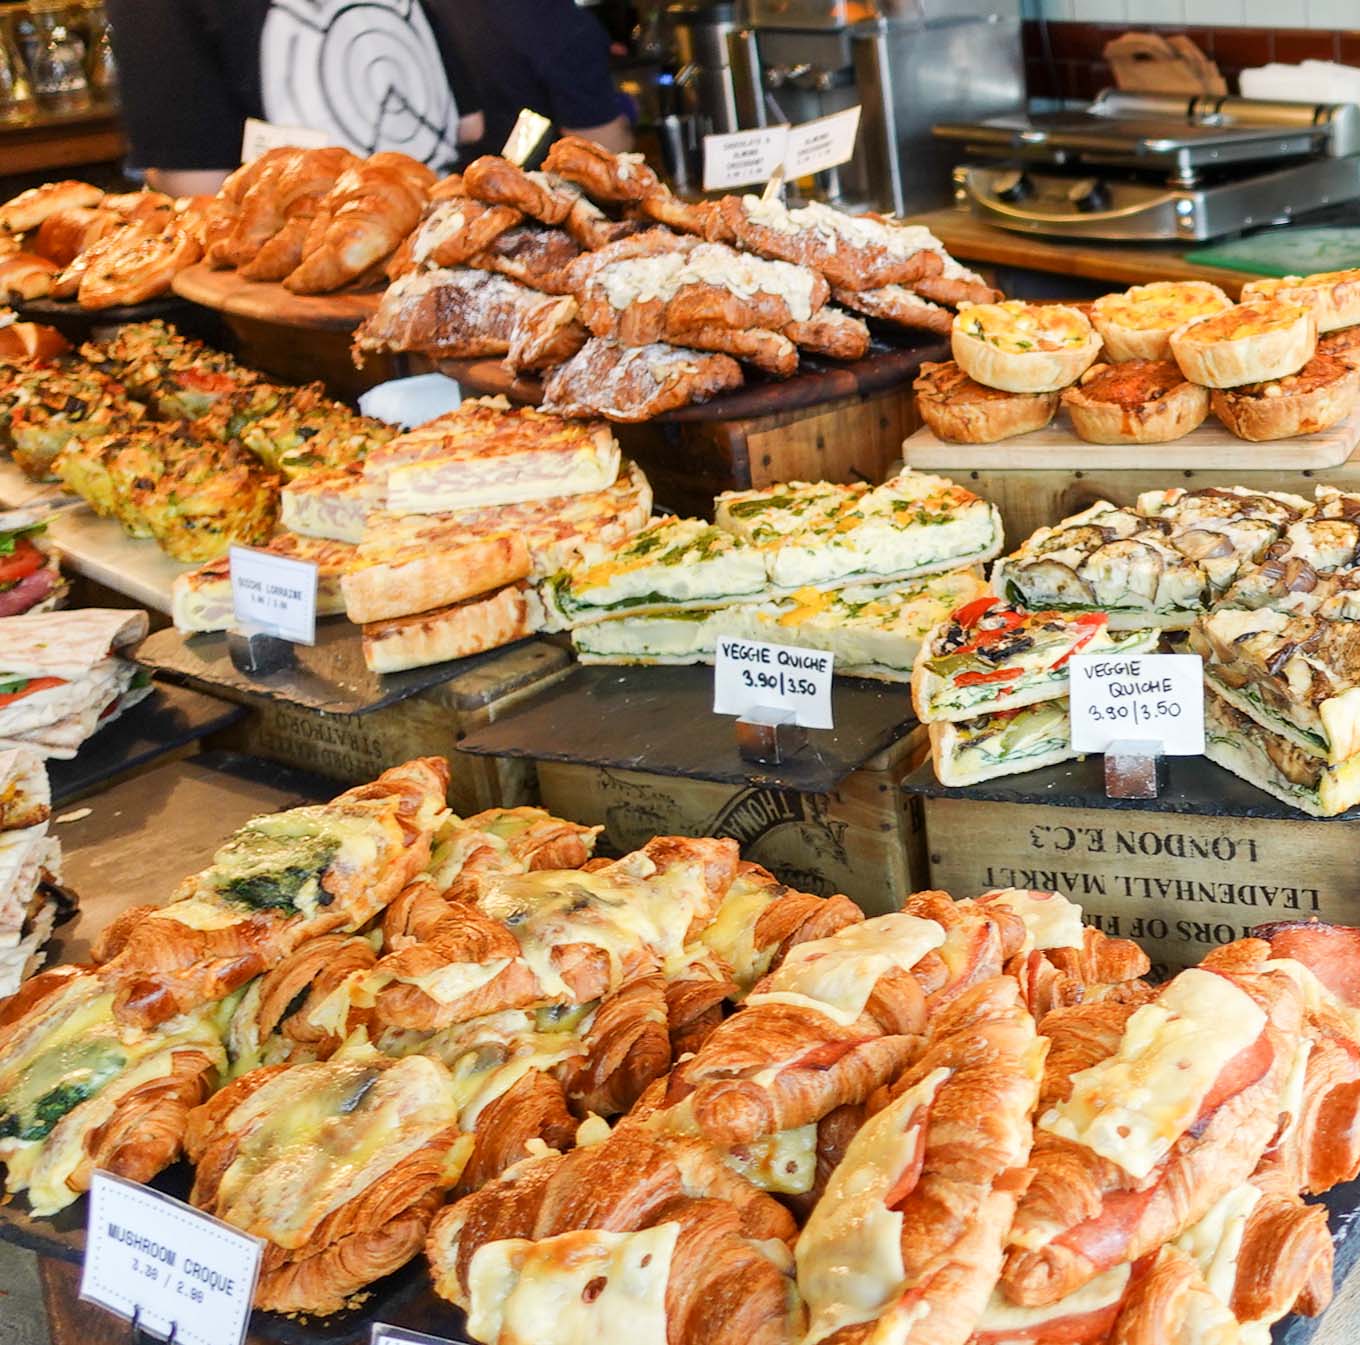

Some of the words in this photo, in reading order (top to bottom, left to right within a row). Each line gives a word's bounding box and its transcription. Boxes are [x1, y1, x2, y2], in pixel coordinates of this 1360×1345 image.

[722, 643, 771, 663] VEGGIE
[777, 651, 828, 673] QUICHE
[1084, 660, 1141, 679] VEGGIE
[1108, 678, 1173, 698] QUICHE
[718, 789, 795, 842] THOMA
[1030, 824, 1105, 853] E.C.3
[1116, 830, 1259, 863] LONDON
[982, 866, 1106, 896] MARKET
[1115, 874, 1322, 912] LEADENHALL
[1131, 917, 1169, 940] OF
[108, 1221, 176, 1266] MUSHROOM
[184, 1258, 235, 1297] CROQUE
